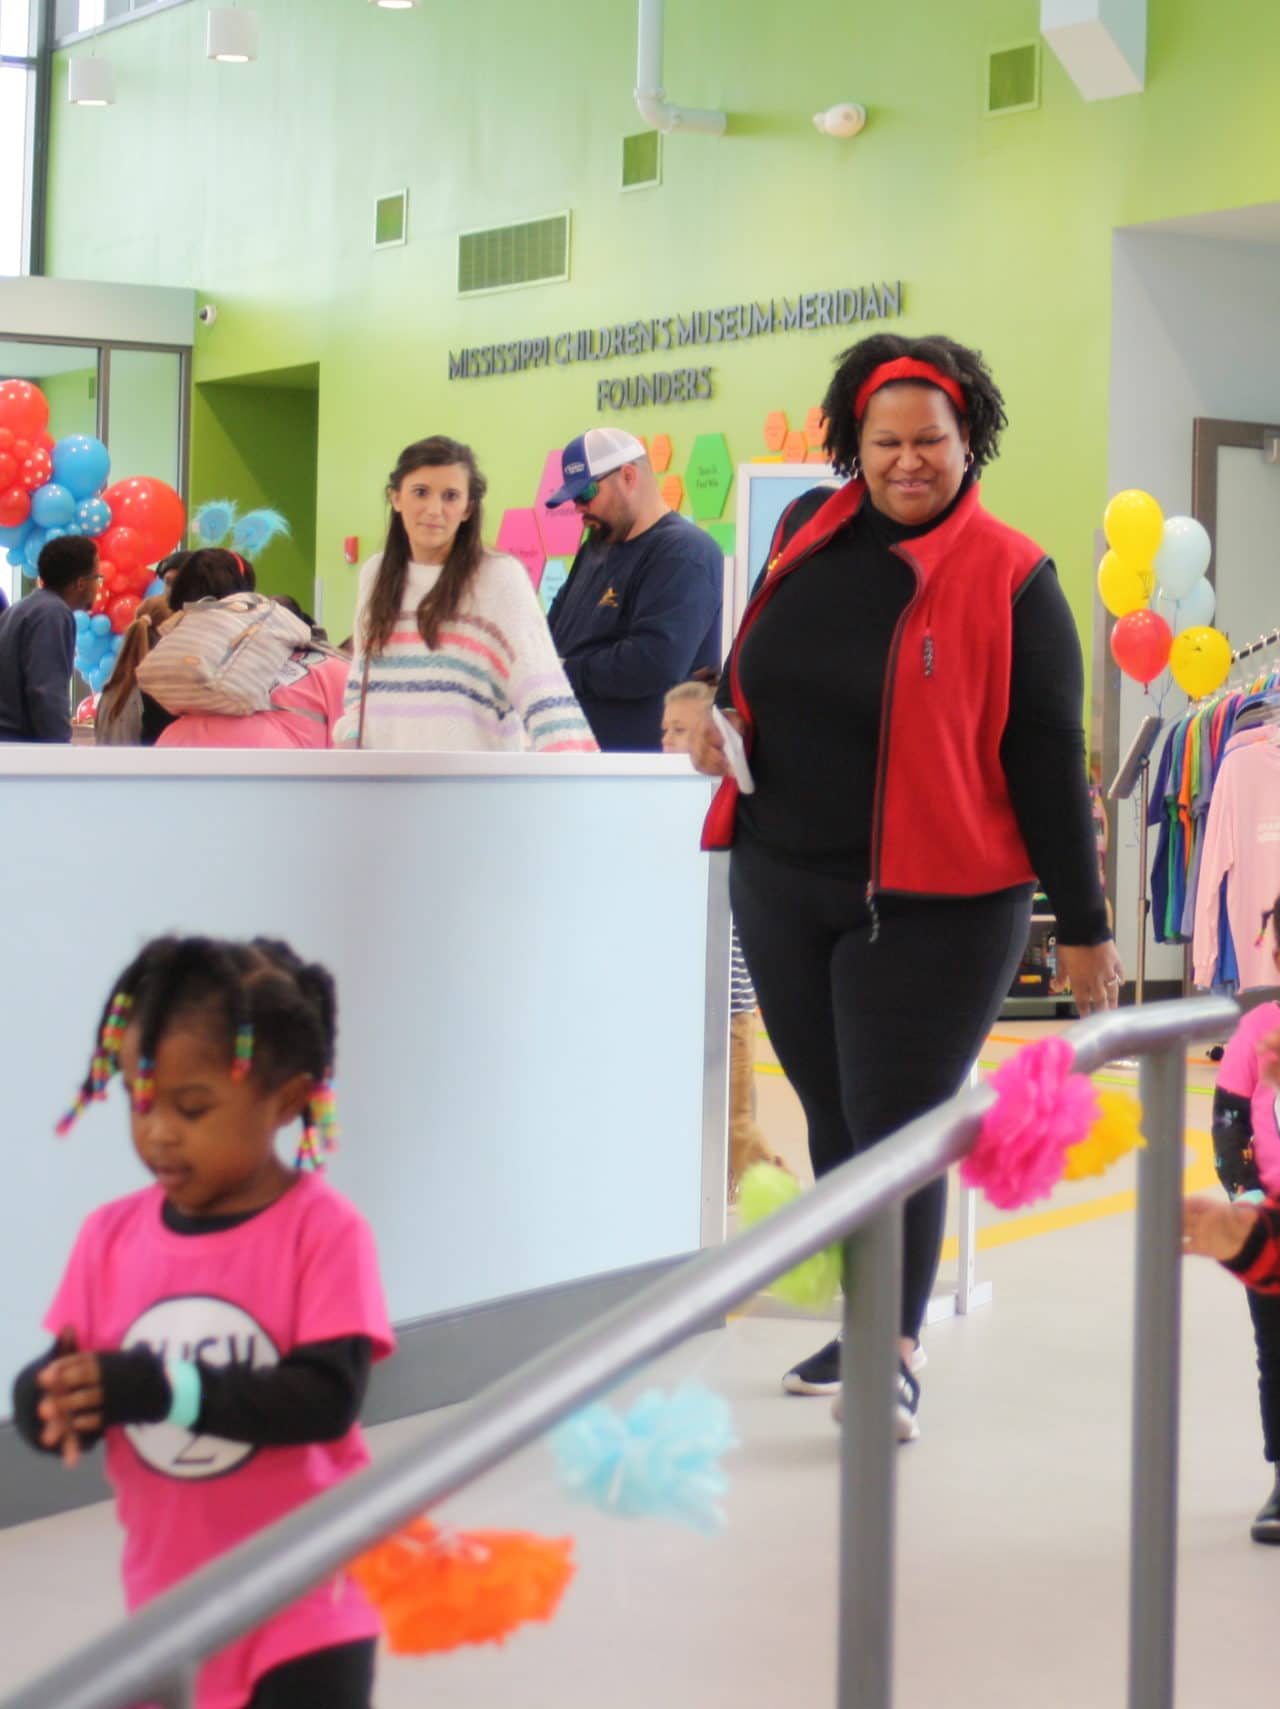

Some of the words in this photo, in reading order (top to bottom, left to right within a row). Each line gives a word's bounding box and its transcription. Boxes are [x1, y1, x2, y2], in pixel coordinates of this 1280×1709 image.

[448, 335, 550, 380] MISSISSIPPI
[553, 315, 673, 366] CHILDREN'S
[596, 366, 712, 411] FOUNDERS
